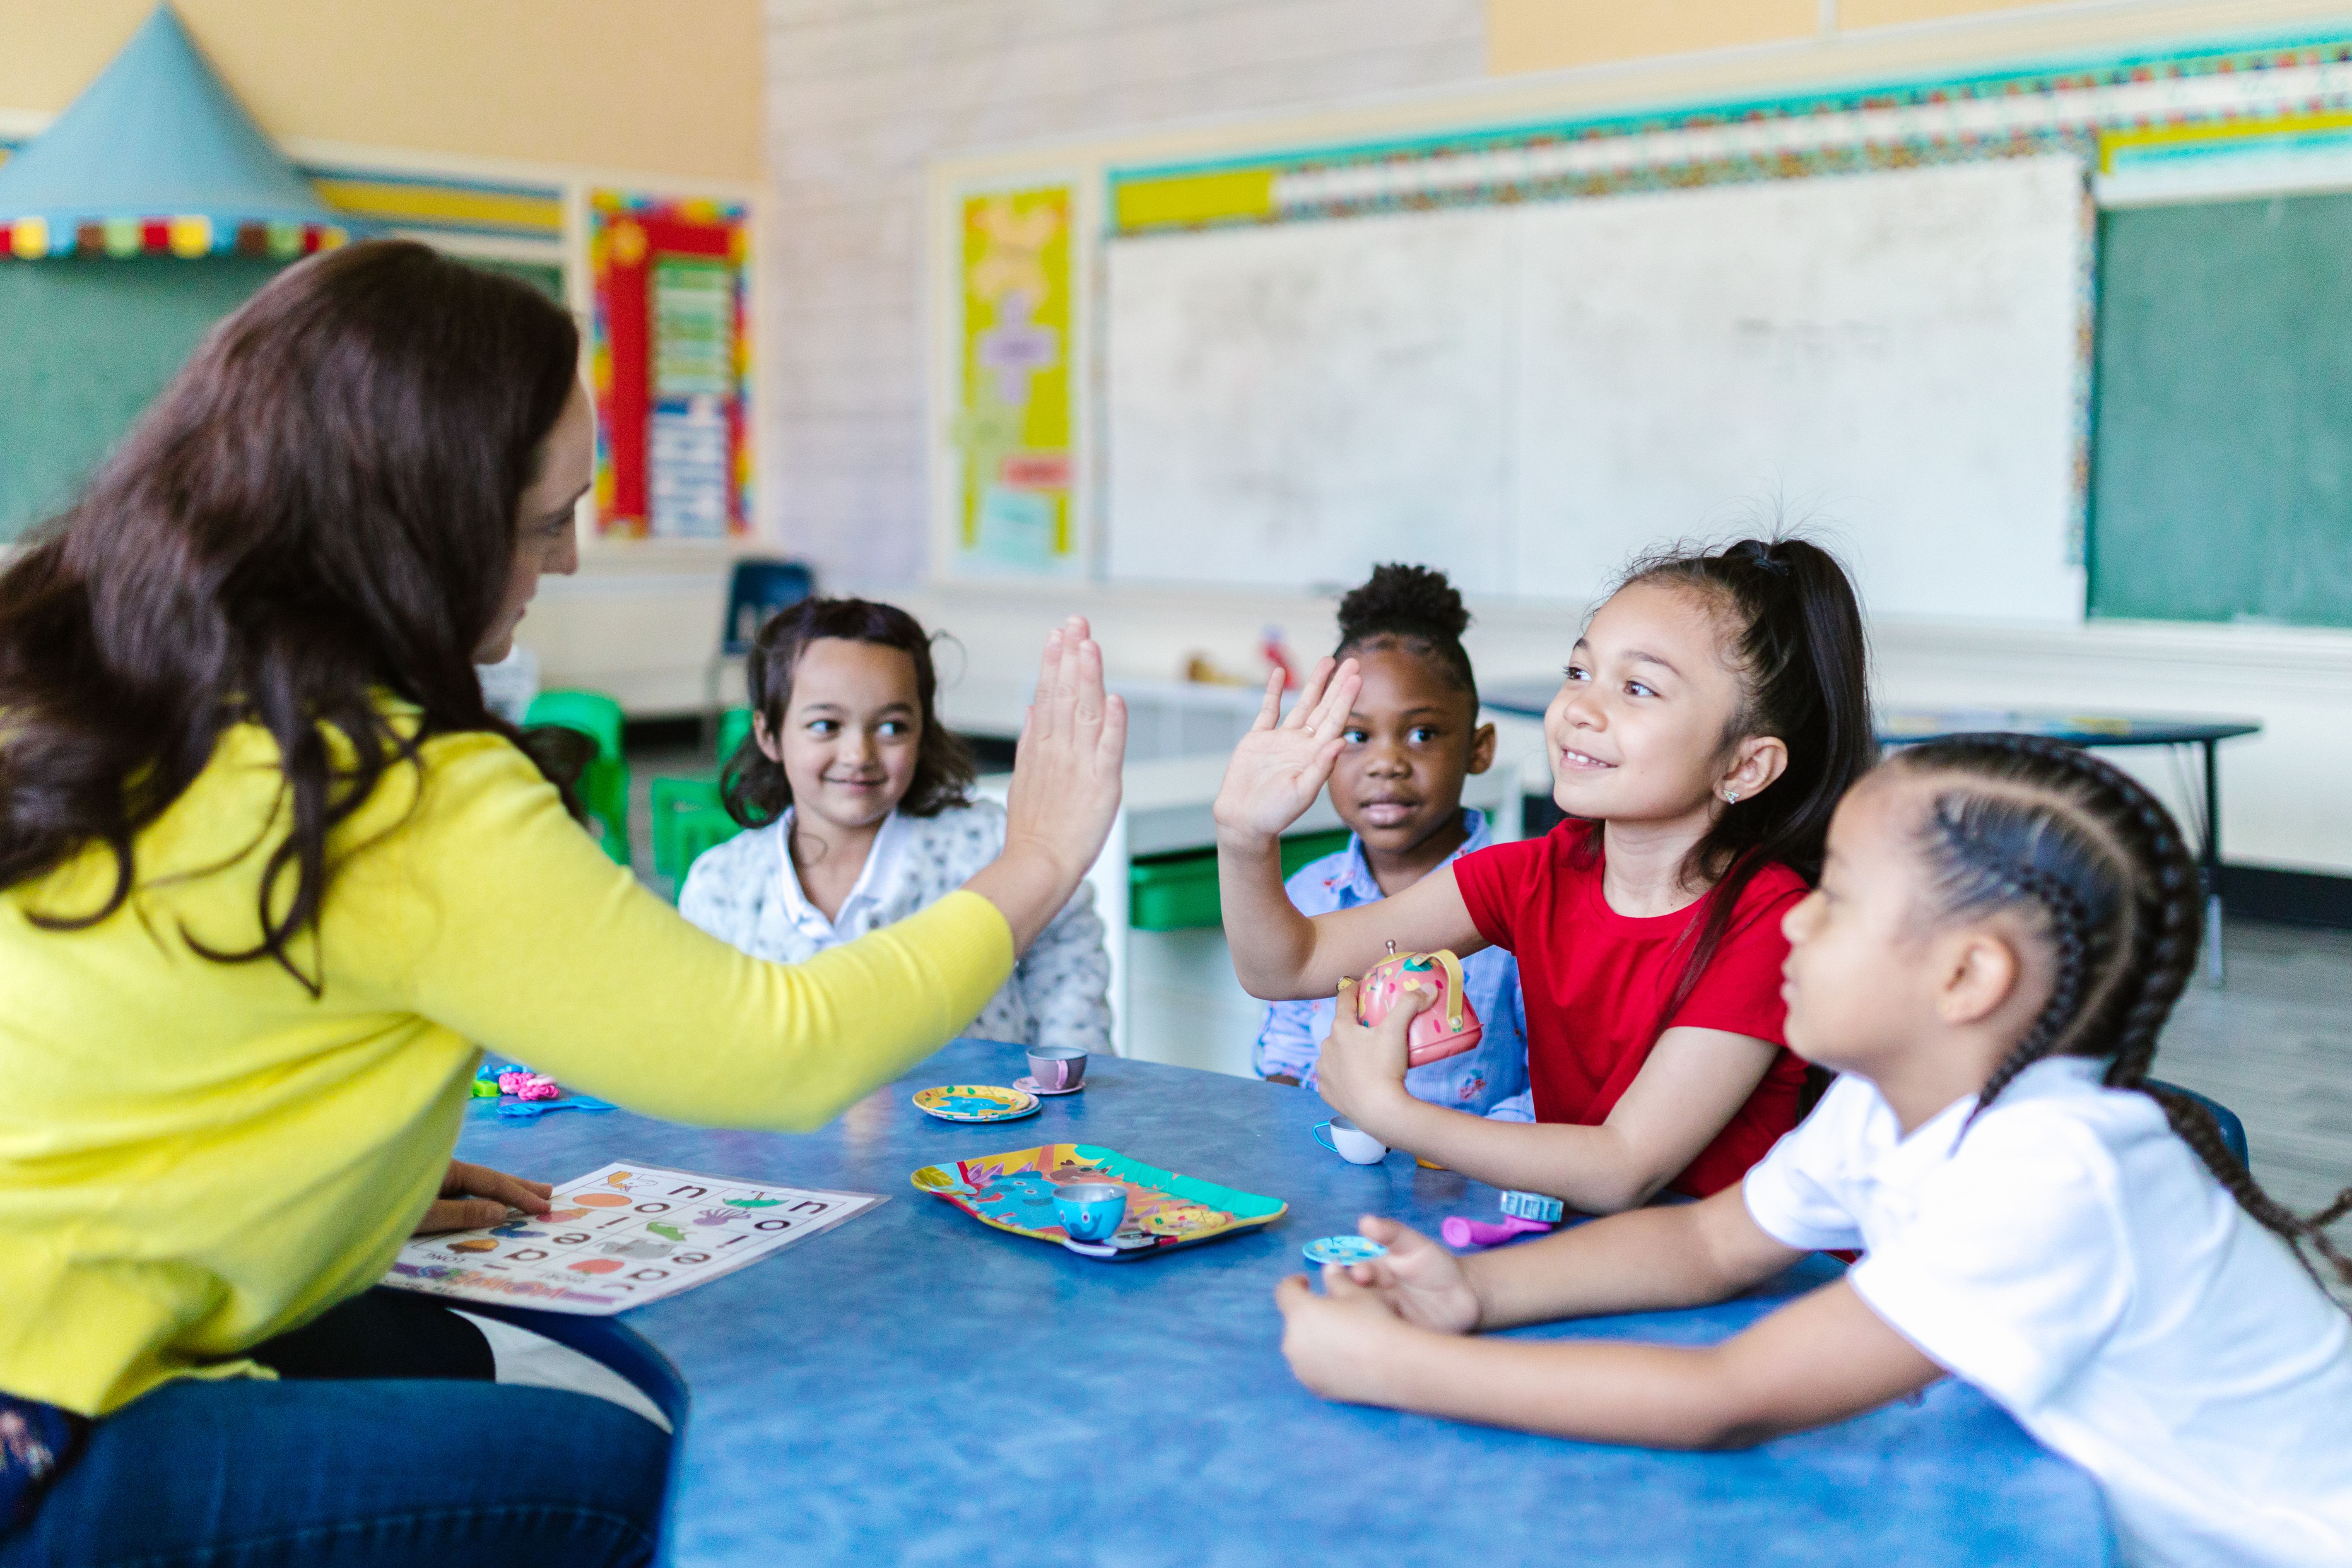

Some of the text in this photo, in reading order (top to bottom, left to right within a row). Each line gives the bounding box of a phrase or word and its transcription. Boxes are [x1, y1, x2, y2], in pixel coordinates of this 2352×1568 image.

[634, 1203, 671, 1213] o
[596, 1216, 630, 1229] i
[754, 1220, 791, 1231] o
[552, 1233, 592, 1244] e
[716, 1235, 749, 1249] i
[503, 1248, 548, 1261] a
[672, 1252, 711, 1264] e
[624, 1268, 670, 1281] a
